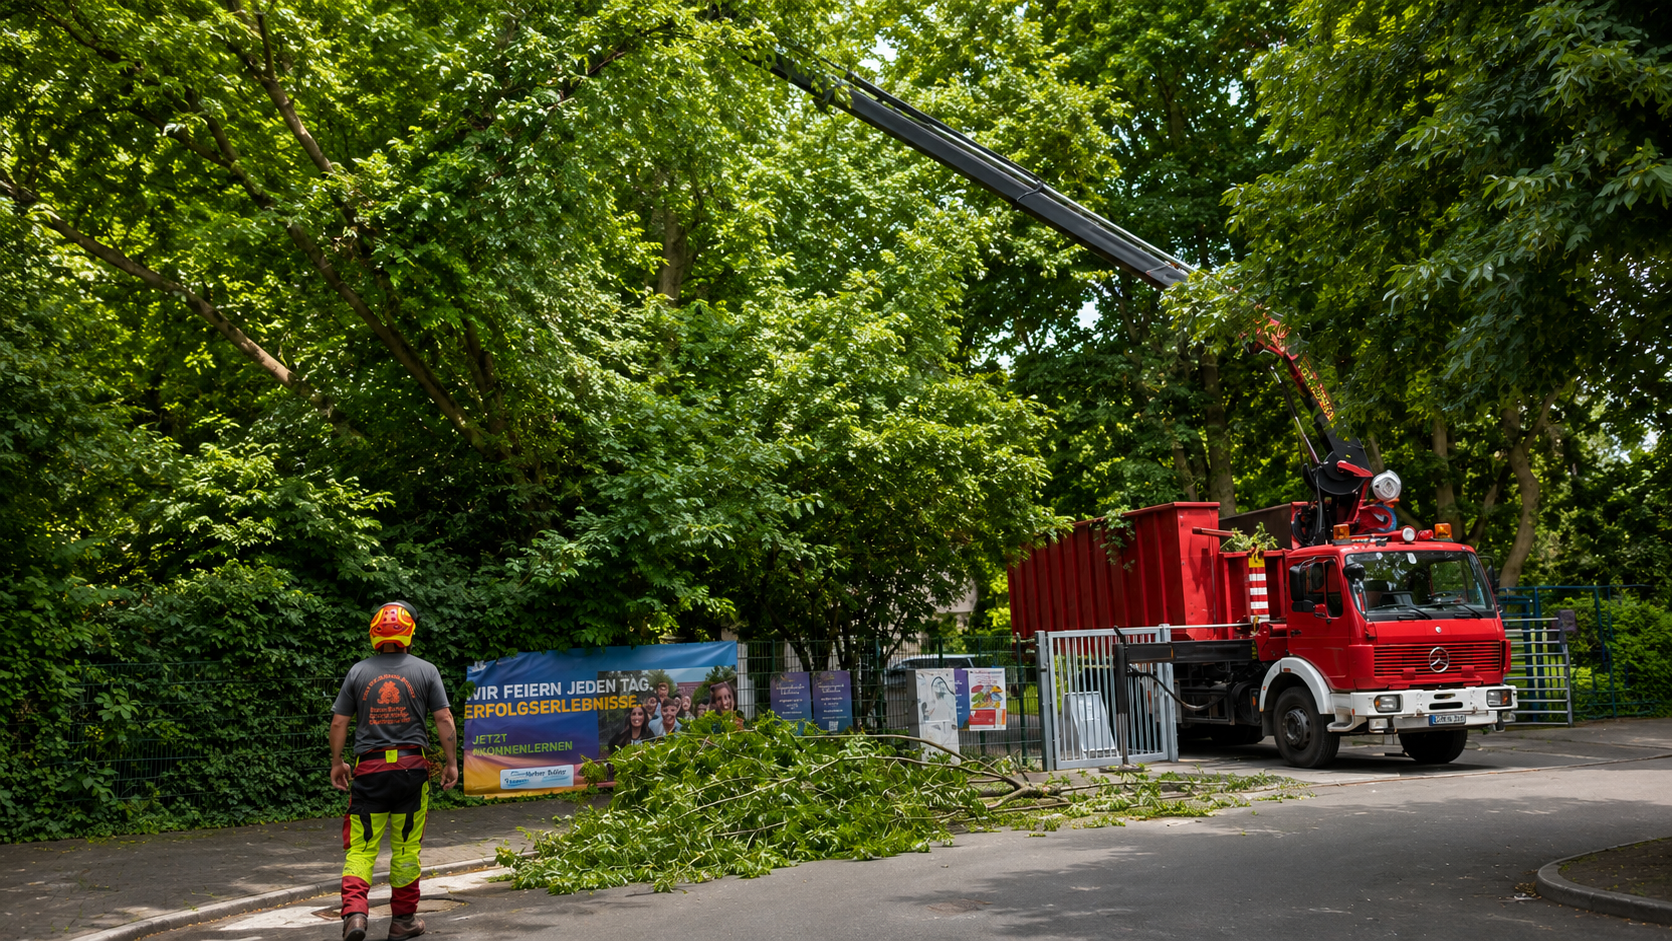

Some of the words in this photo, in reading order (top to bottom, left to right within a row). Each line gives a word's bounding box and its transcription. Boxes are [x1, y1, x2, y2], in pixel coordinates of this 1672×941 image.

[467, 685, 499, 701] WIR
[503, 681, 562, 699] FEIERN
[566, 678, 616, 695] JEDEN
[619, 676, 654, 692] TAG.
[472, 733, 508, 745] JETZT
